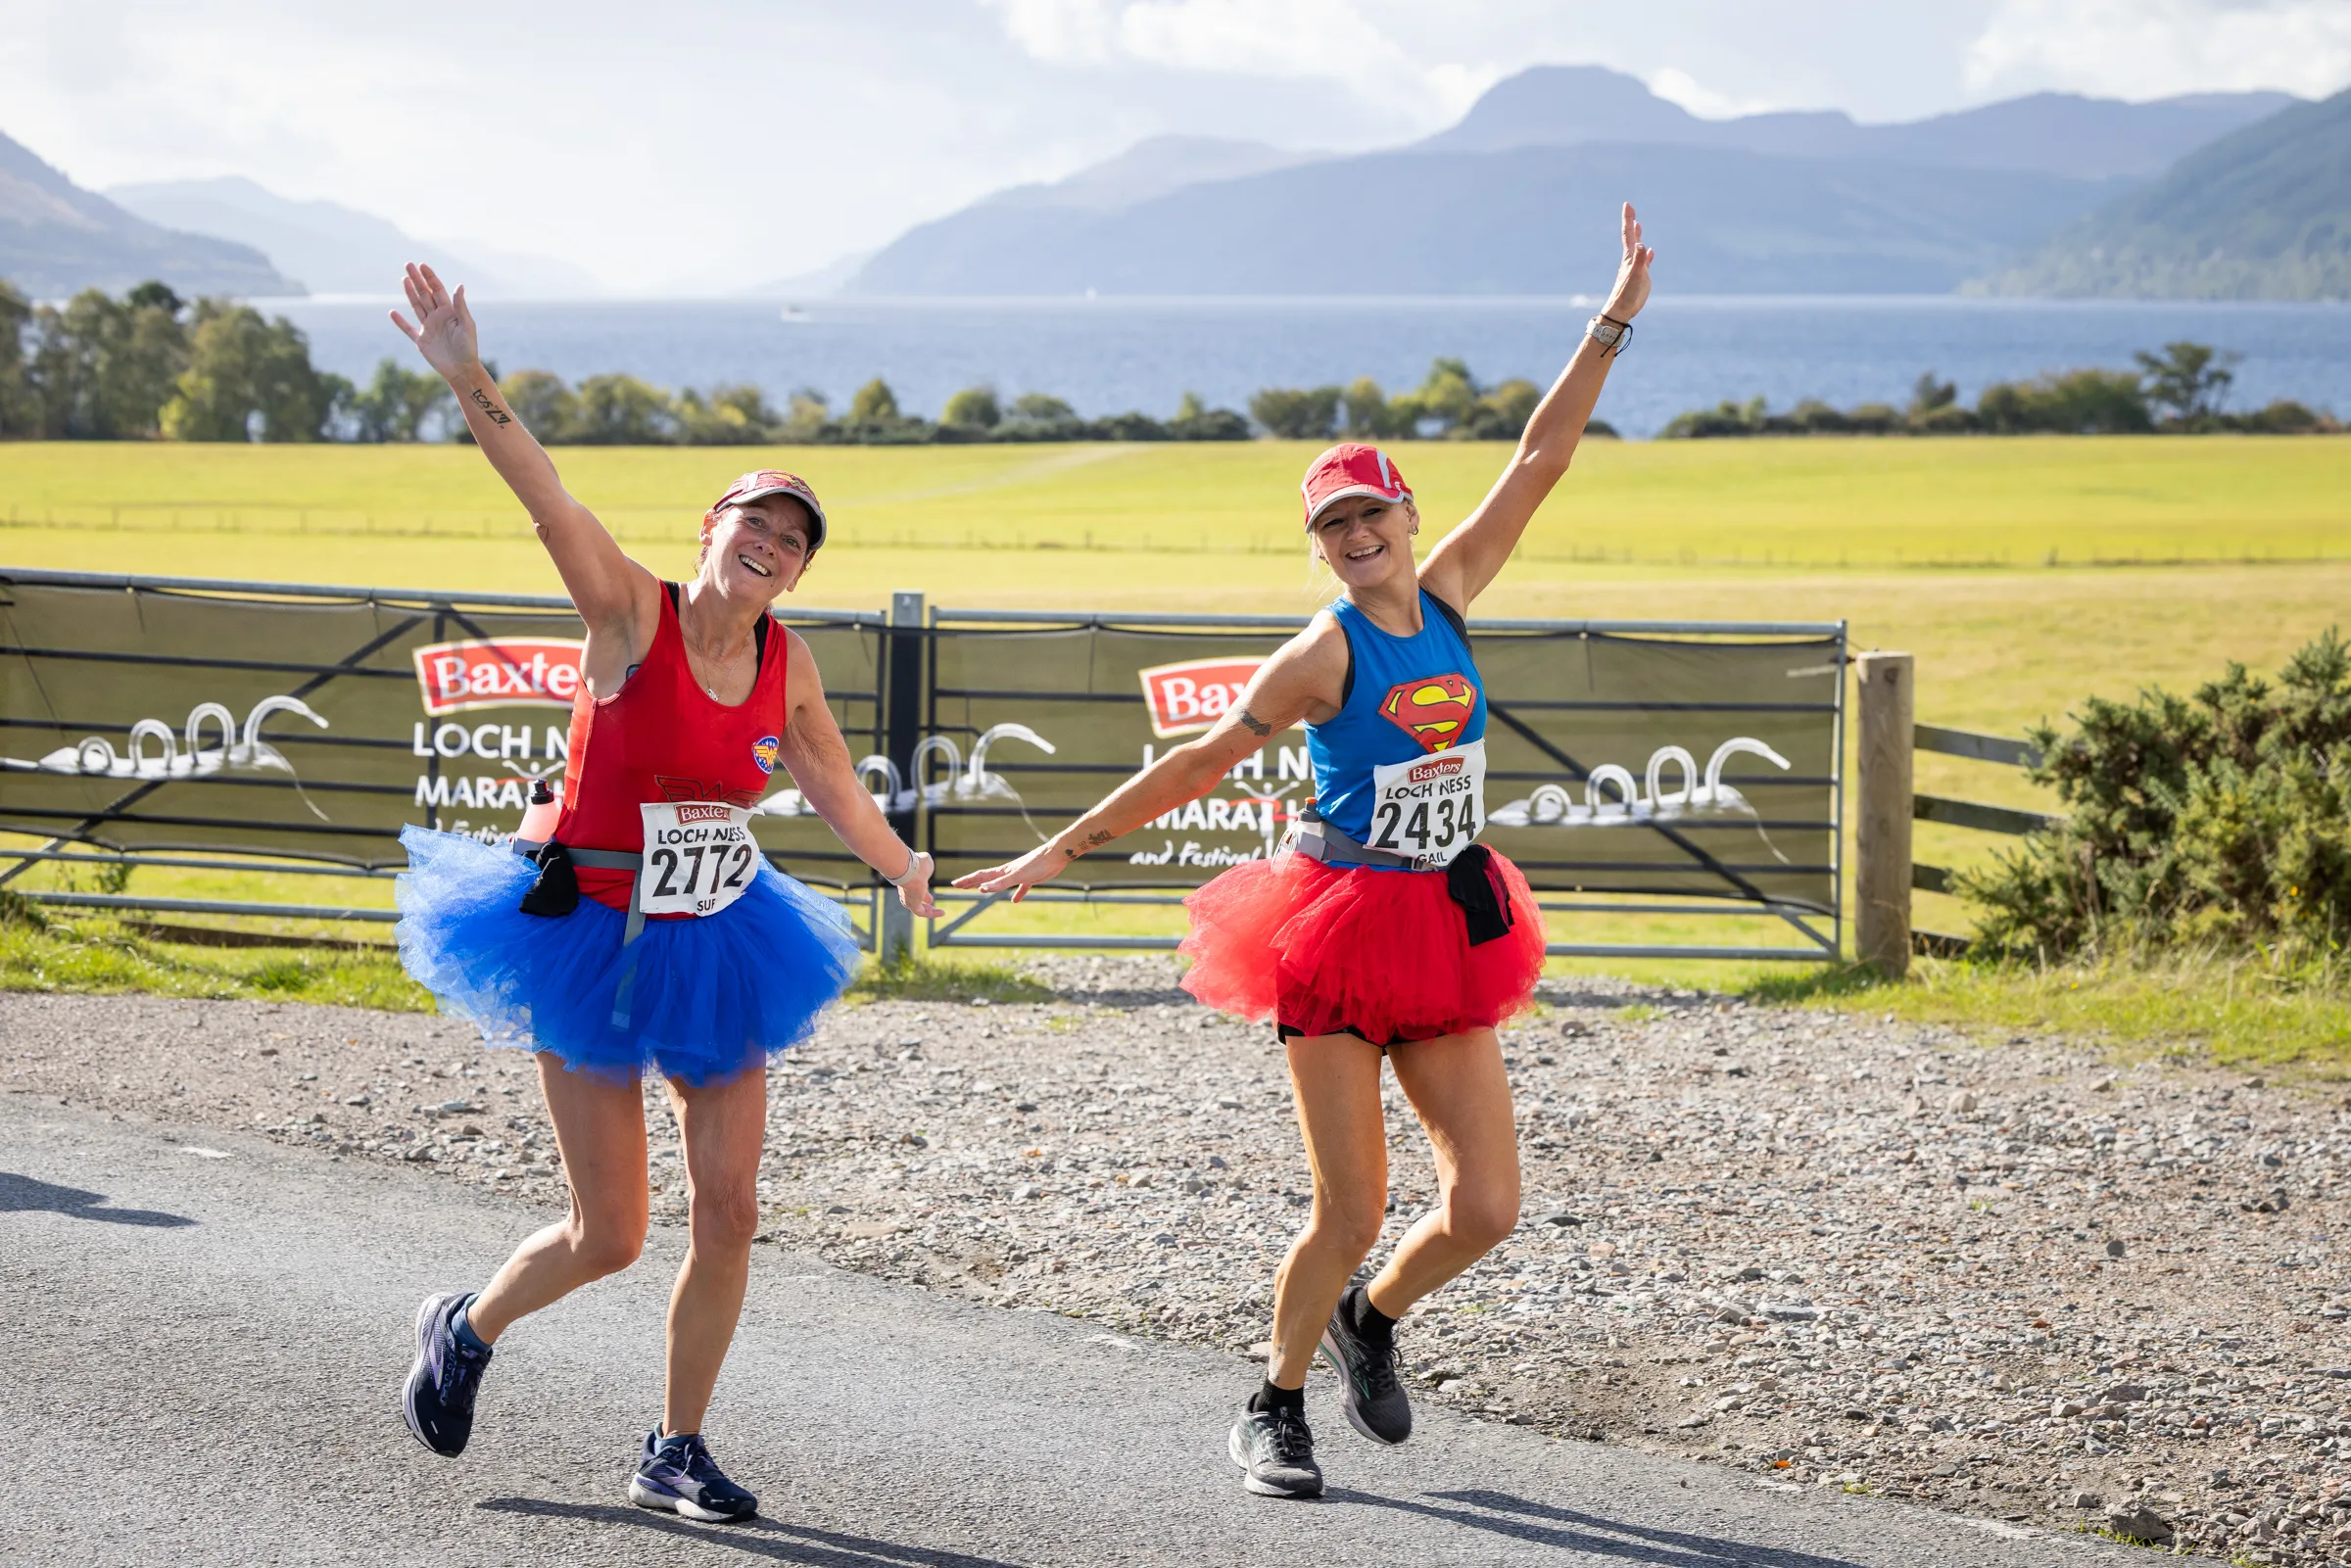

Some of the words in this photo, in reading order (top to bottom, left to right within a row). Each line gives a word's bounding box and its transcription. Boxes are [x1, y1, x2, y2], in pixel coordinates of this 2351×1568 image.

[413, 722, 532, 759] LOCH
[1413, 762, 1462, 781] Baxters
[1385, 783, 1433, 800] LOCH
[1439, 775, 1471, 795] NESS
[1374, 793, 1476, 850] 2434
[657, 829, 708, 844] LOCH
[713, 827, 745, 842] NESS
[1129, 839, 1174, 866] and
[1178, 840, 1263, 867] Festival
[1417, 851, 1447, 864] GAIL
[651, 843, 752, 897] 2772
